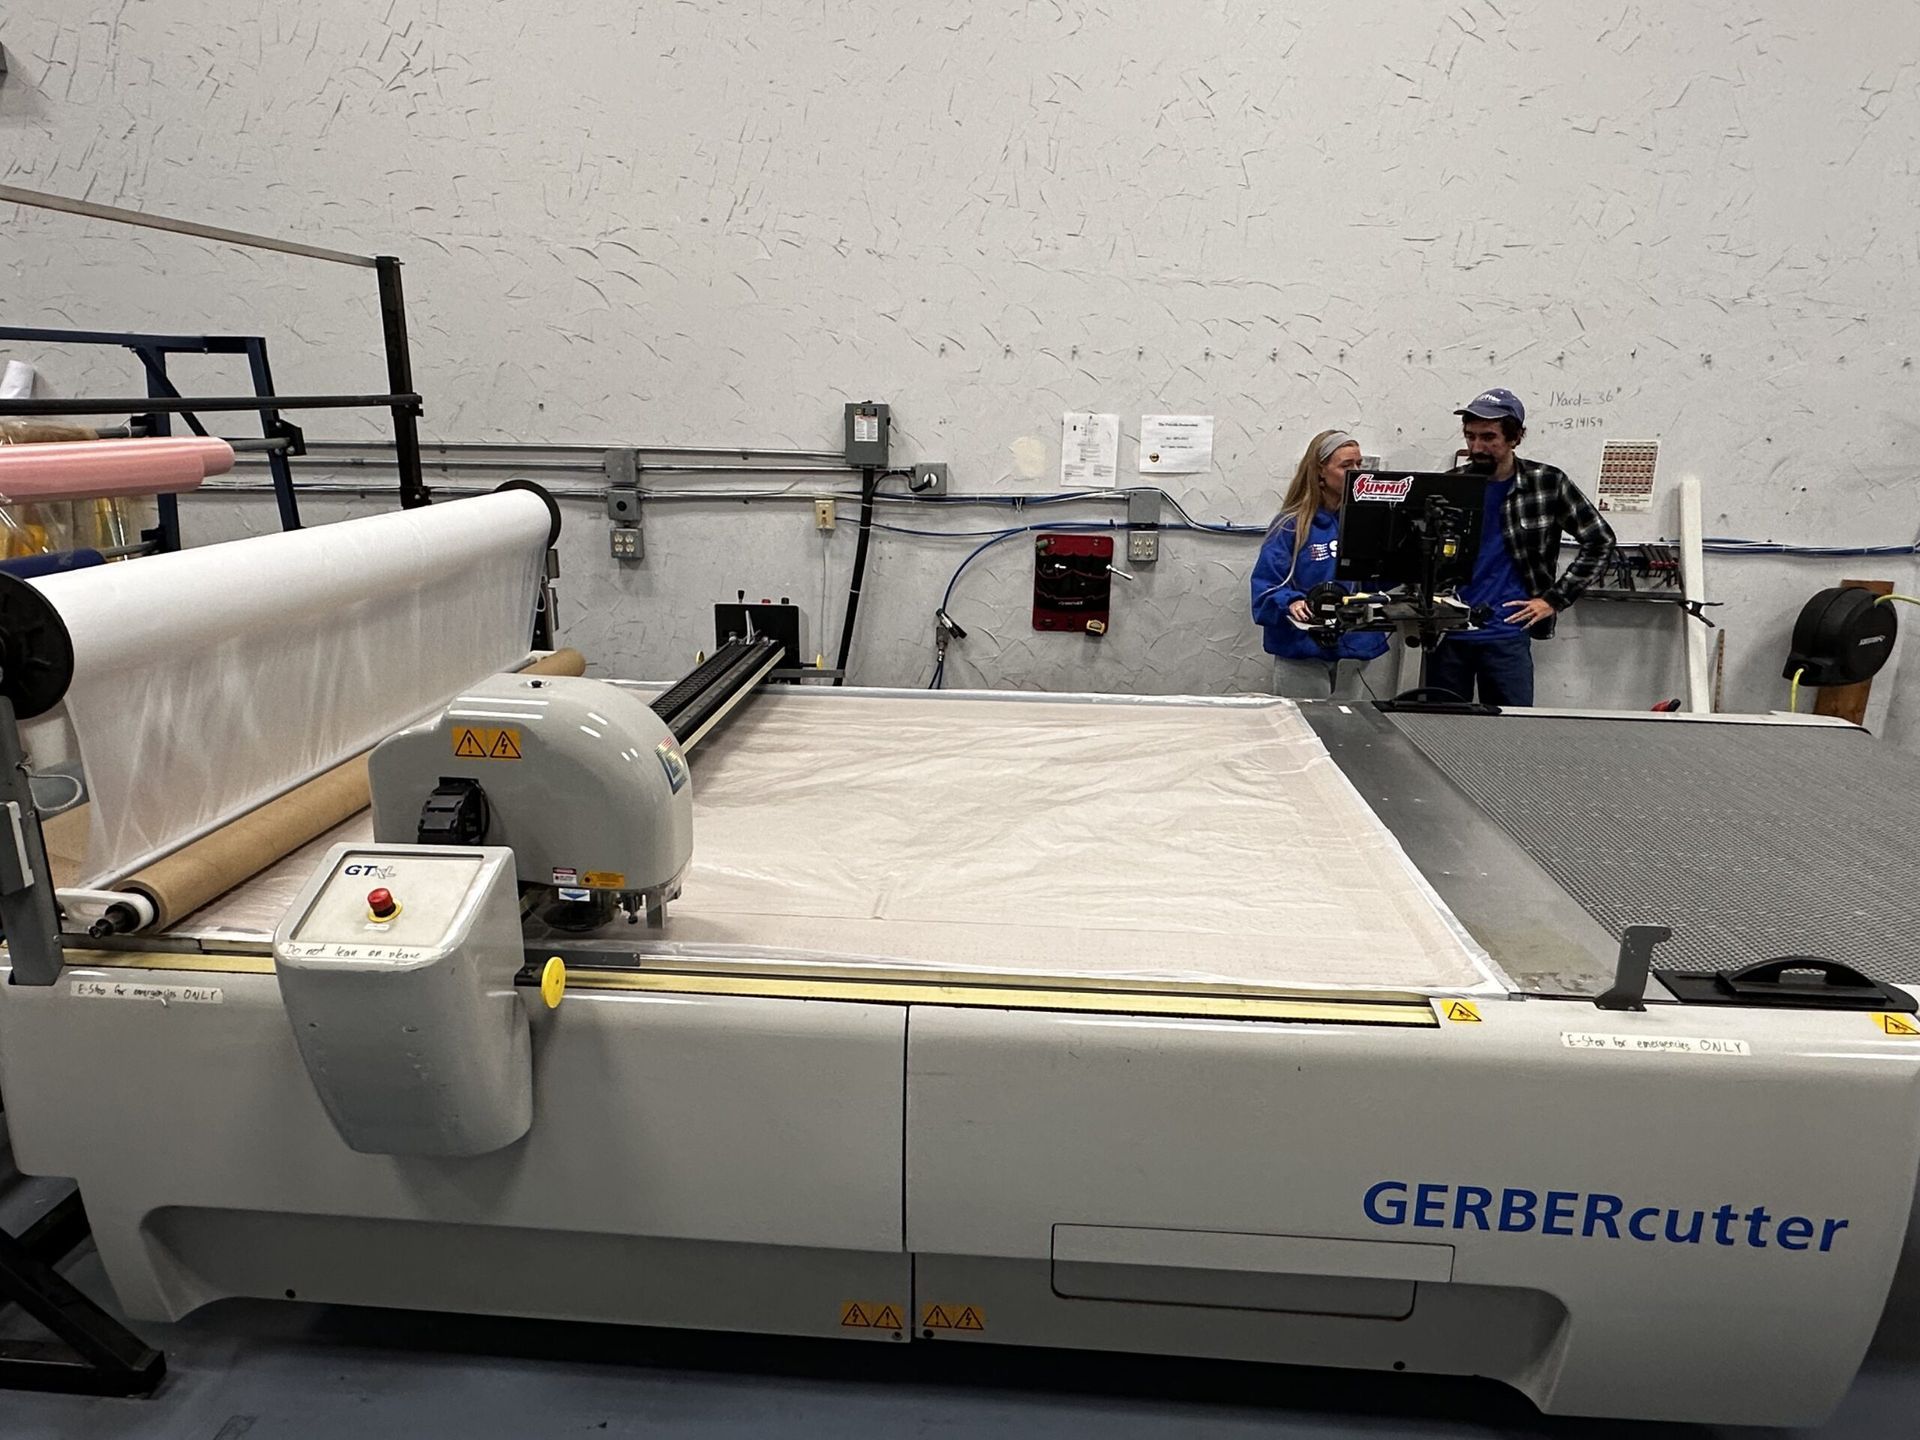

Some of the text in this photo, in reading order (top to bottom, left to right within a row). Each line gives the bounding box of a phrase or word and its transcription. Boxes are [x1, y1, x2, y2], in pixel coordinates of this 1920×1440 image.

[284, 943, 301, 955] Do
[305, 943, 326, 956] not
[334, 945, 358, 957] lean
[388, 948, 422, 960] please
[114, 984, 127, 996] for
[183, 988, 218, 1000] ONLY
[1567, 1034, 1742, 1053] E-Stop for emergencies ONLY
[1362, 1180, 1850, 1252] GERBERcutter
